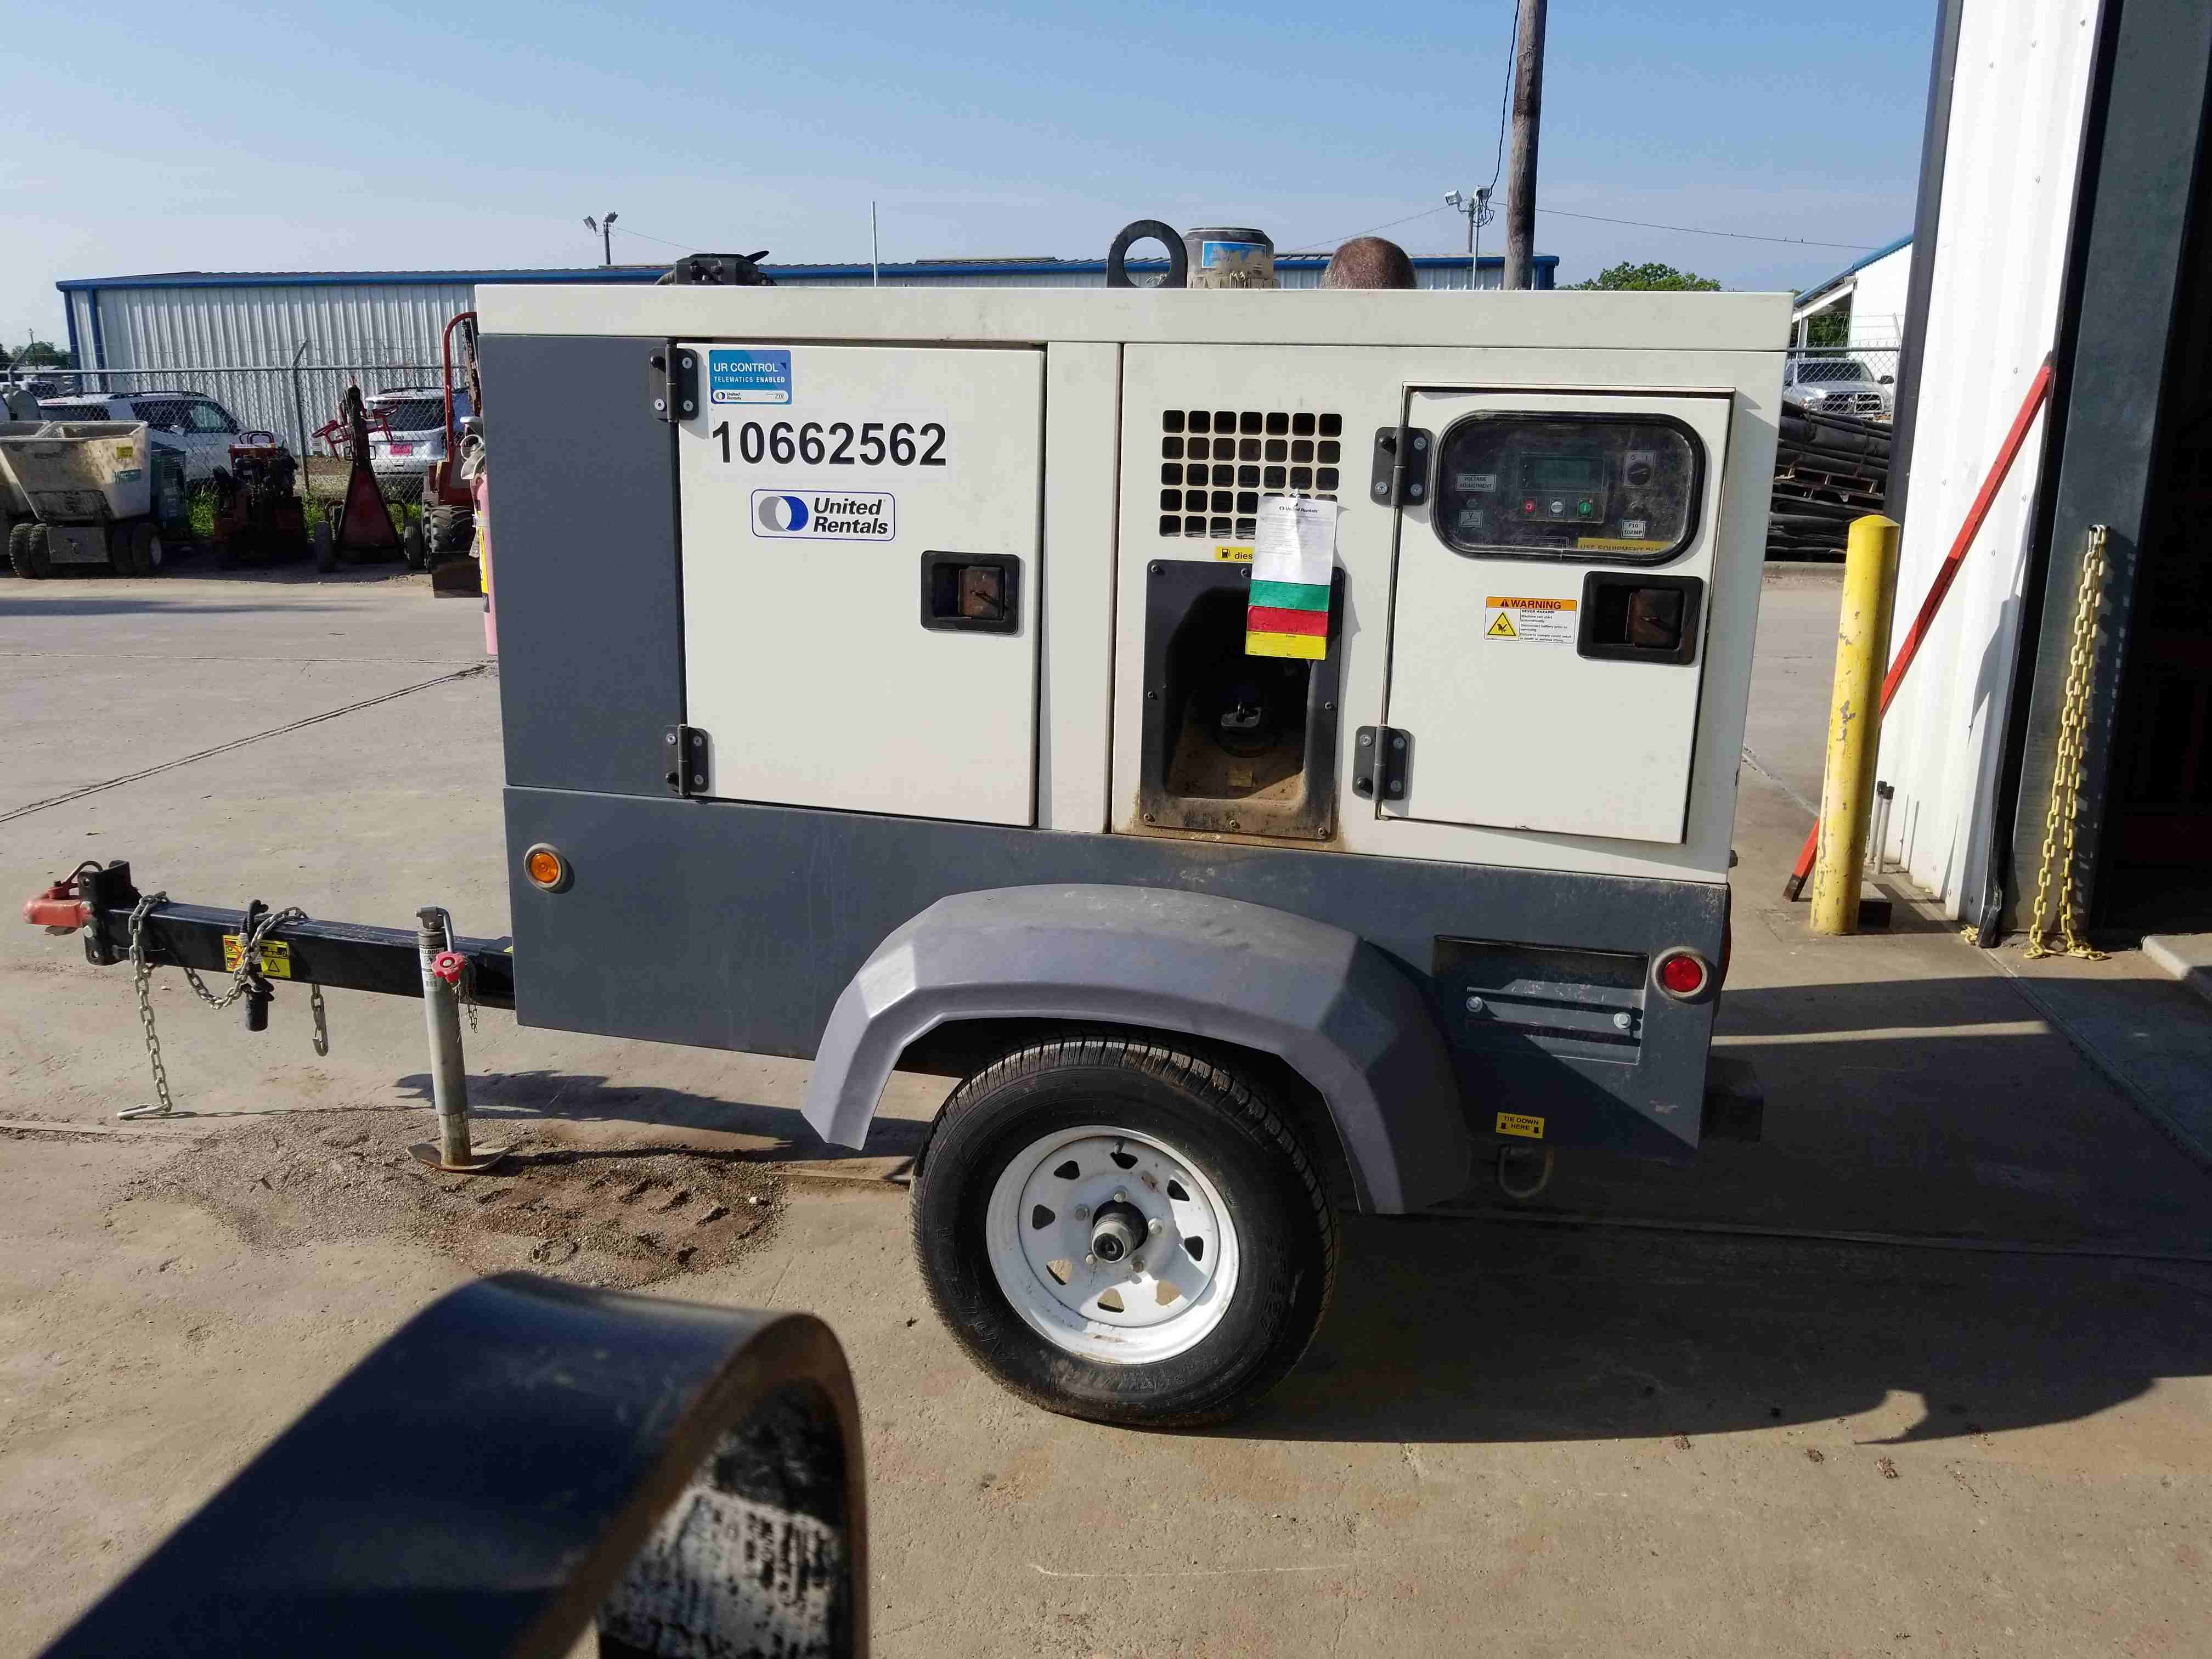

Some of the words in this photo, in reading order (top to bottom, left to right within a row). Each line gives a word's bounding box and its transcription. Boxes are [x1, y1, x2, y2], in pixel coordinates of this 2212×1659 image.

[713, 363, 728, 372] UR
[730, 363, 778, 373] CONTROL
[712, 421, 947, 466] 10662562
[813, 497, 882, 516] United
[813, 516, 888, 535] Rentals
[1511, 600, 1561, 610] WARNING
